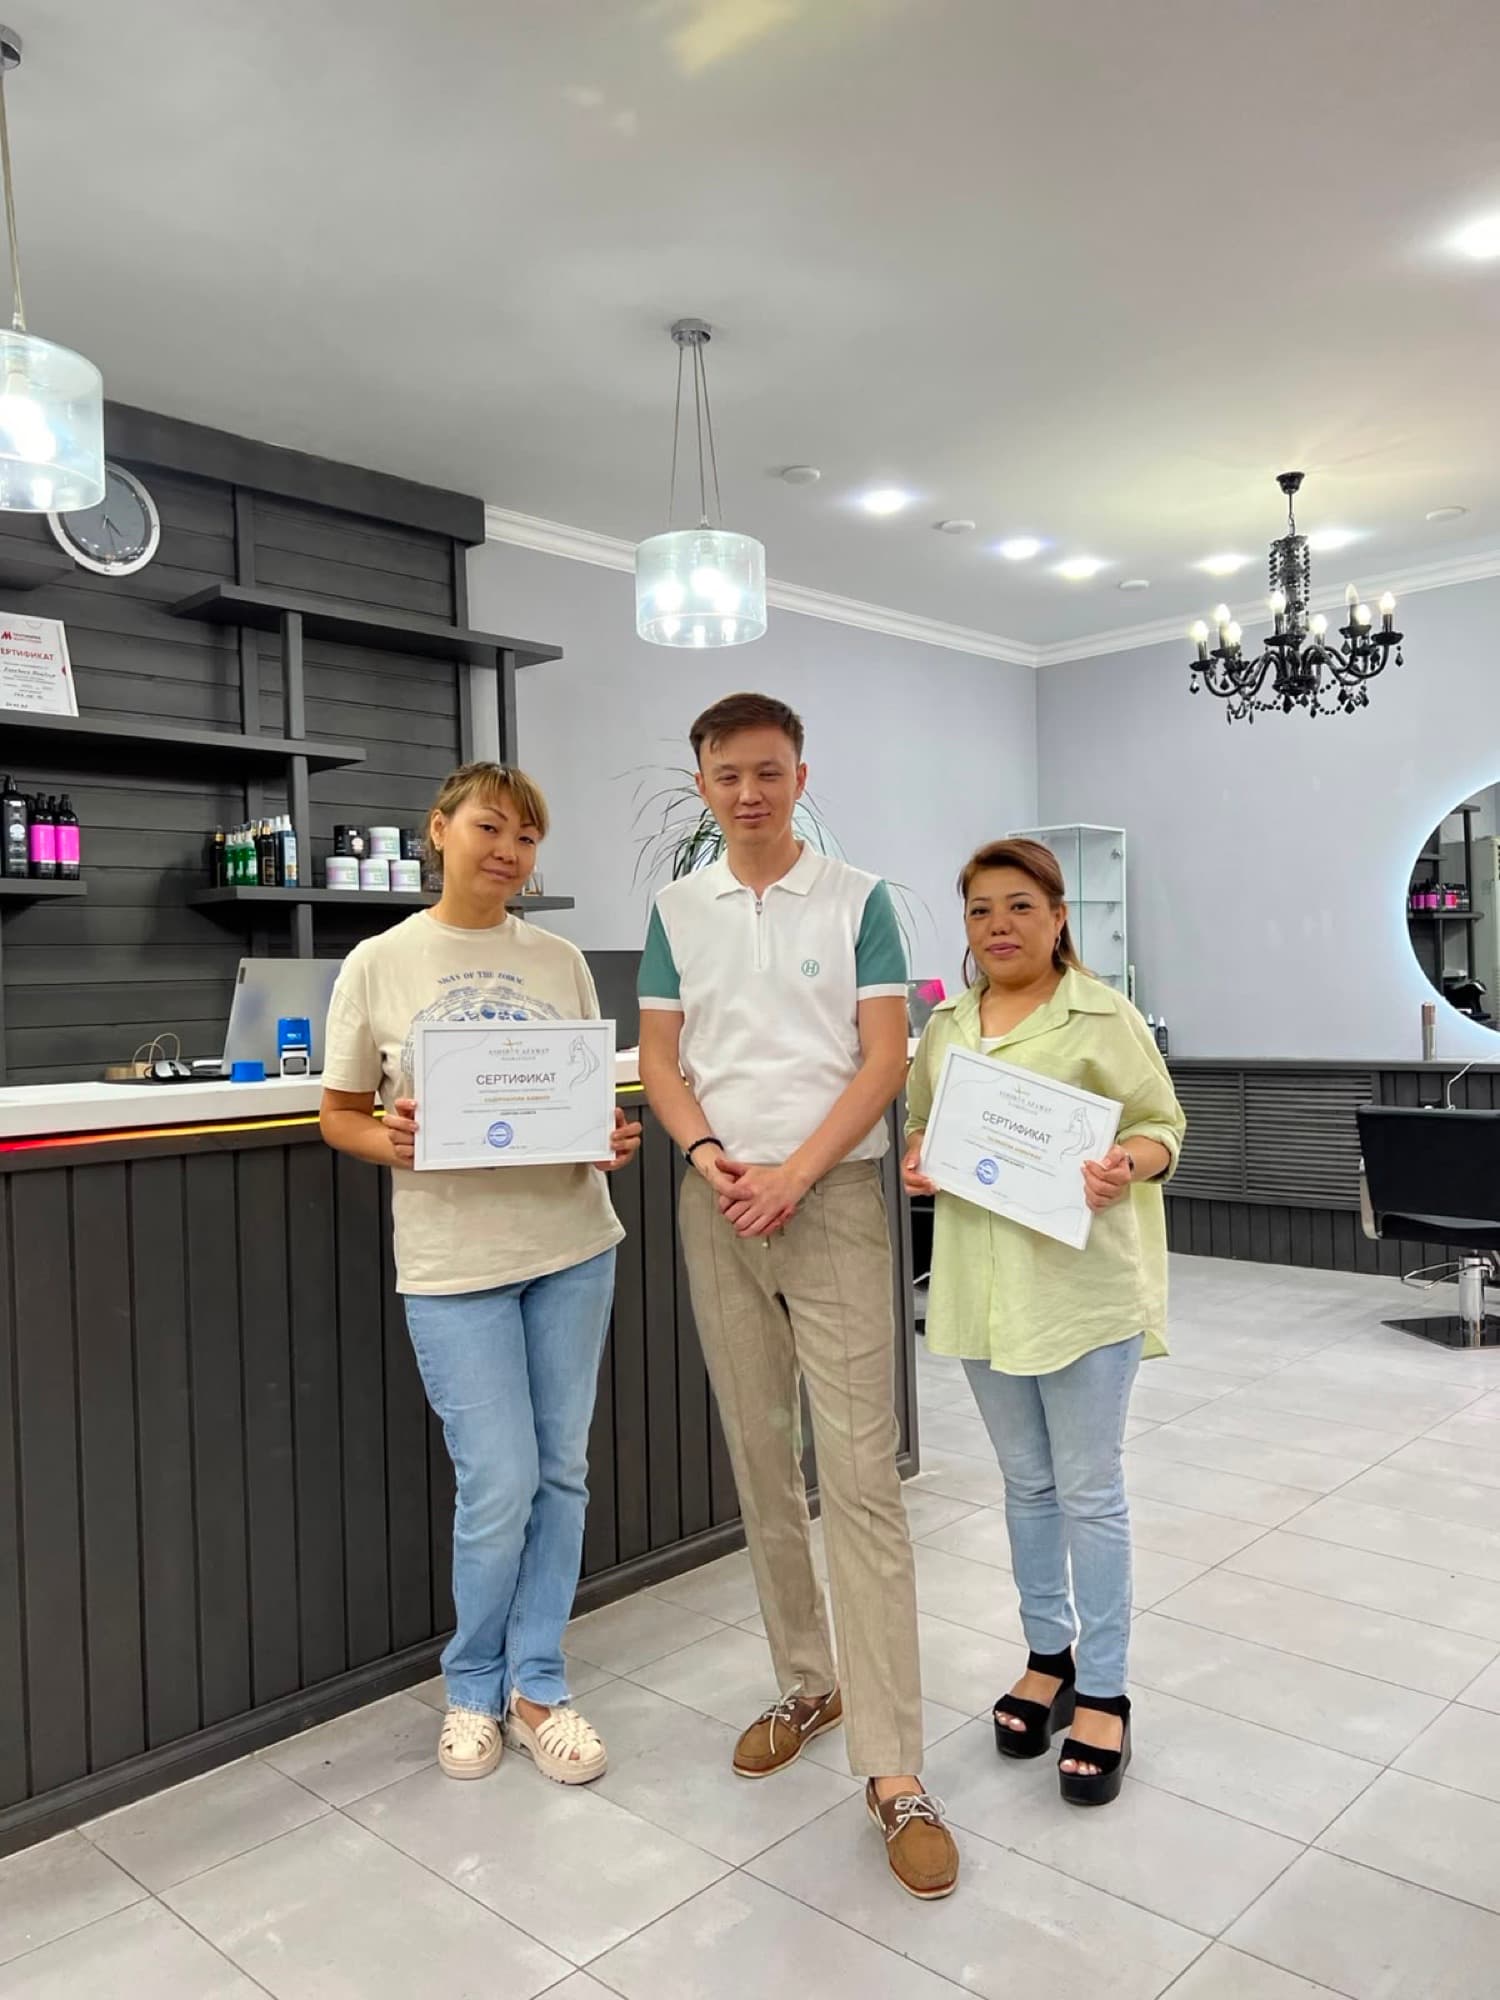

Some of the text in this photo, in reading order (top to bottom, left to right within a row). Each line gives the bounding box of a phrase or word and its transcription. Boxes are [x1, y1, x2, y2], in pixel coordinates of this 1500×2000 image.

[0, 647, 54, 661] ЕРТИФИКАТ
[477, 970, 494, 979] THE
[476, 1072, 556, 1086] СЕРТИФИКАТ
[982, 1110, 1052, 1145] СЕРТИФИКАТ
